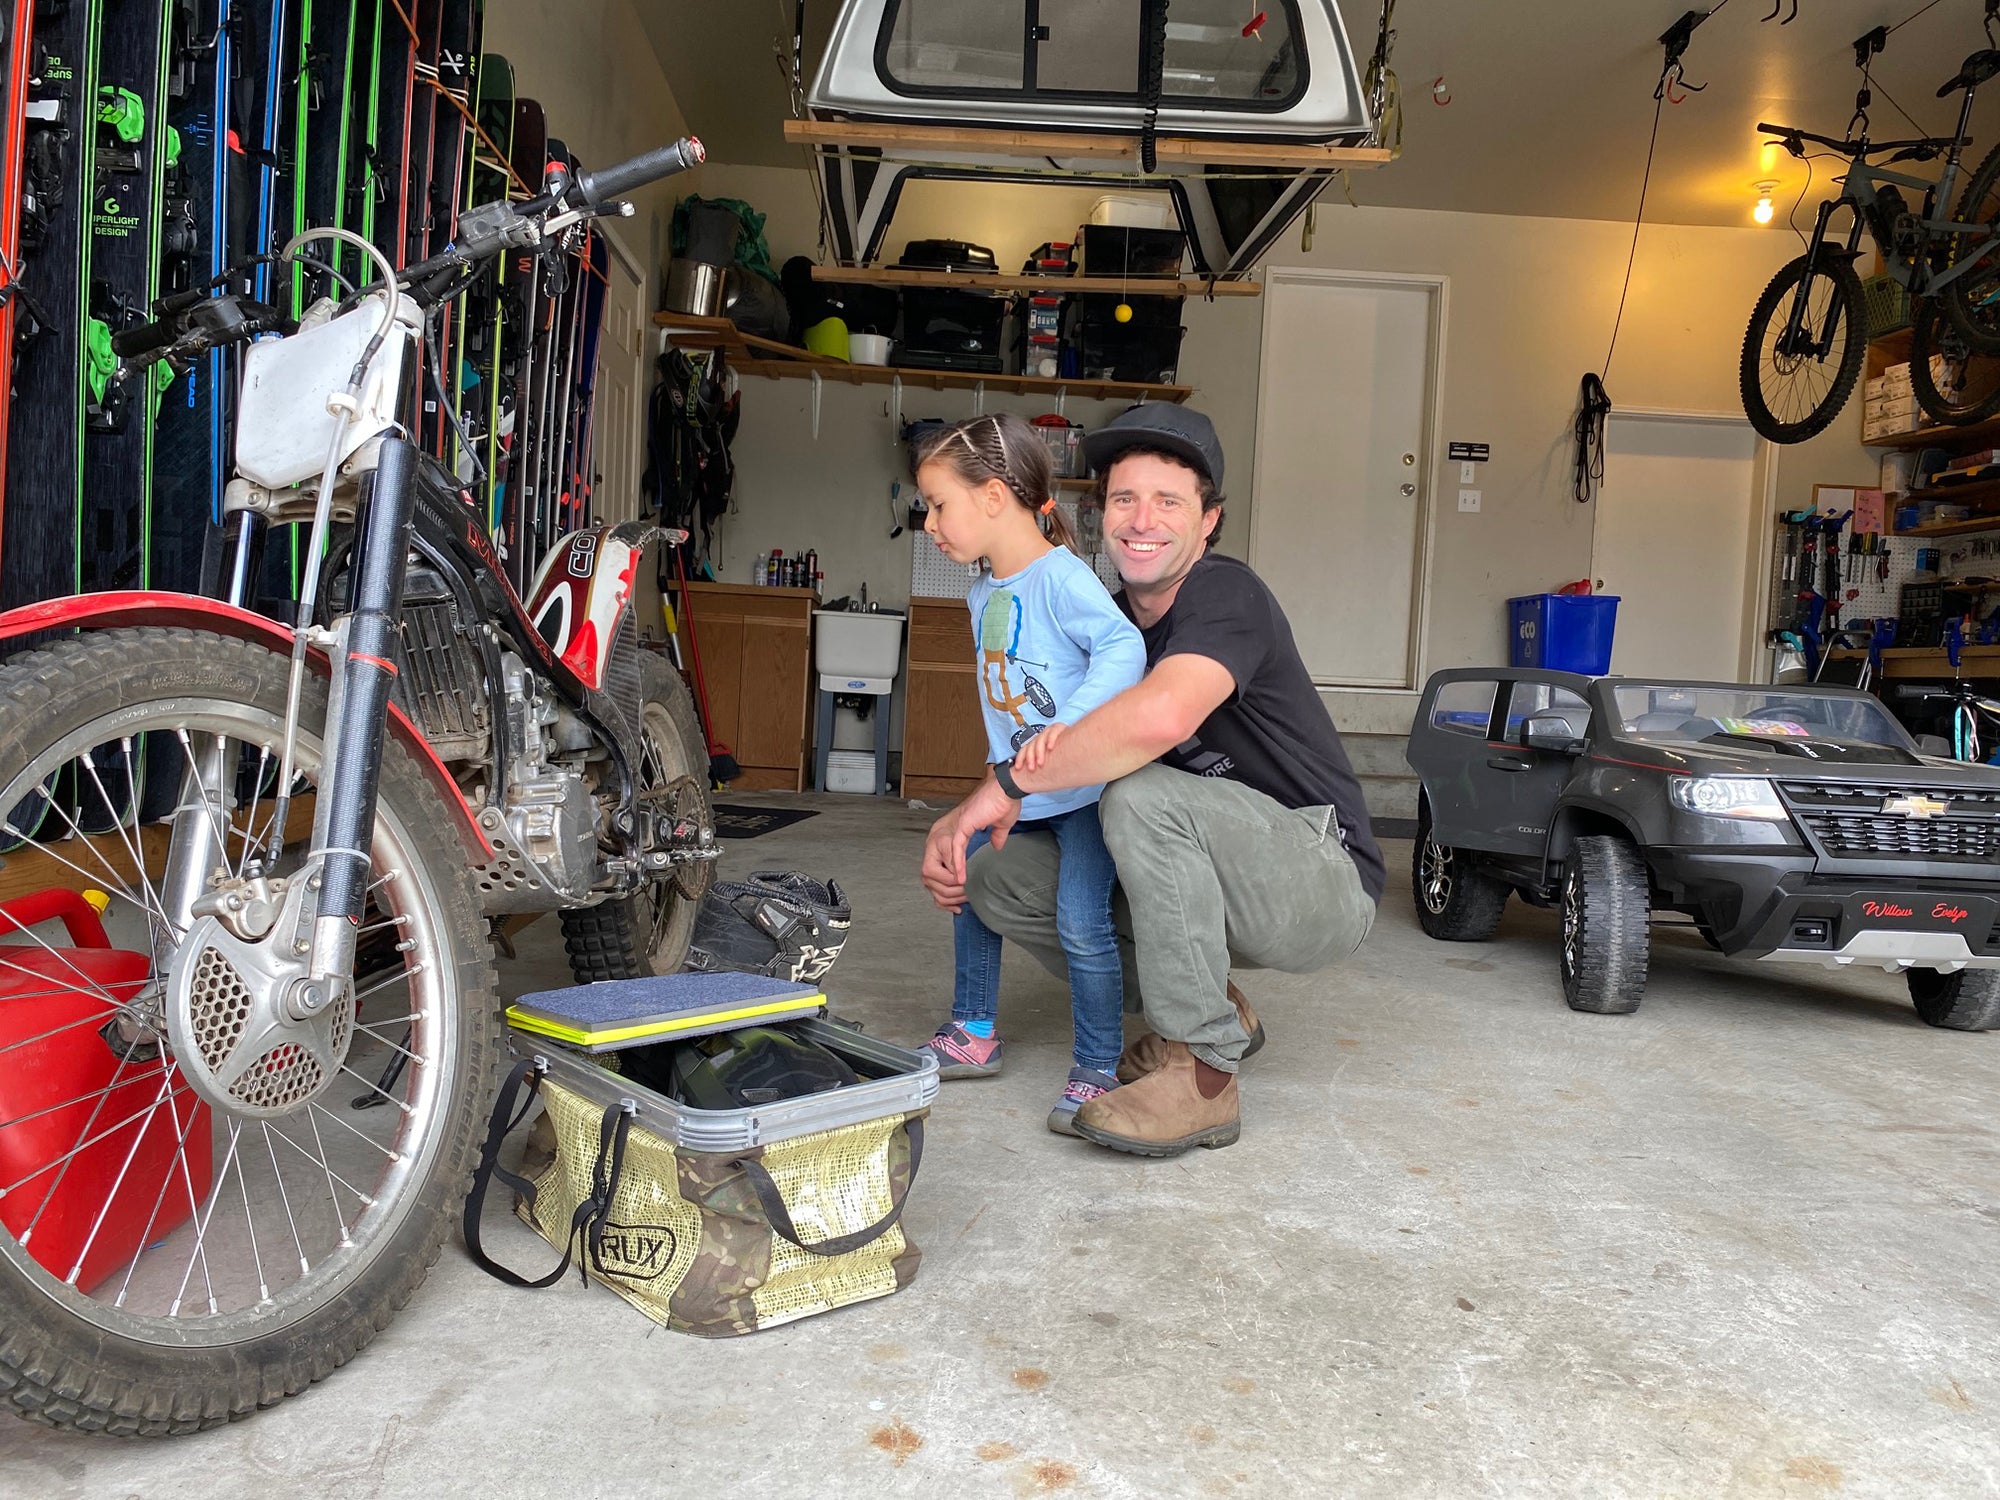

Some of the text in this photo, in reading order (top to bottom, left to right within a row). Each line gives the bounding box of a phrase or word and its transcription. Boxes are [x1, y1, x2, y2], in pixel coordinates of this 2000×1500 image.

[47, 56, 61, 66] DE
[46, 69, 73, 79] SUPE
[94, 227, 129, 237] DESIGN
[1947, 214, 1964, 270] MAXXS
[1862, 901, 1968, 923] Willow Evelyn
[600, 1234, 665, 1270] RUX
